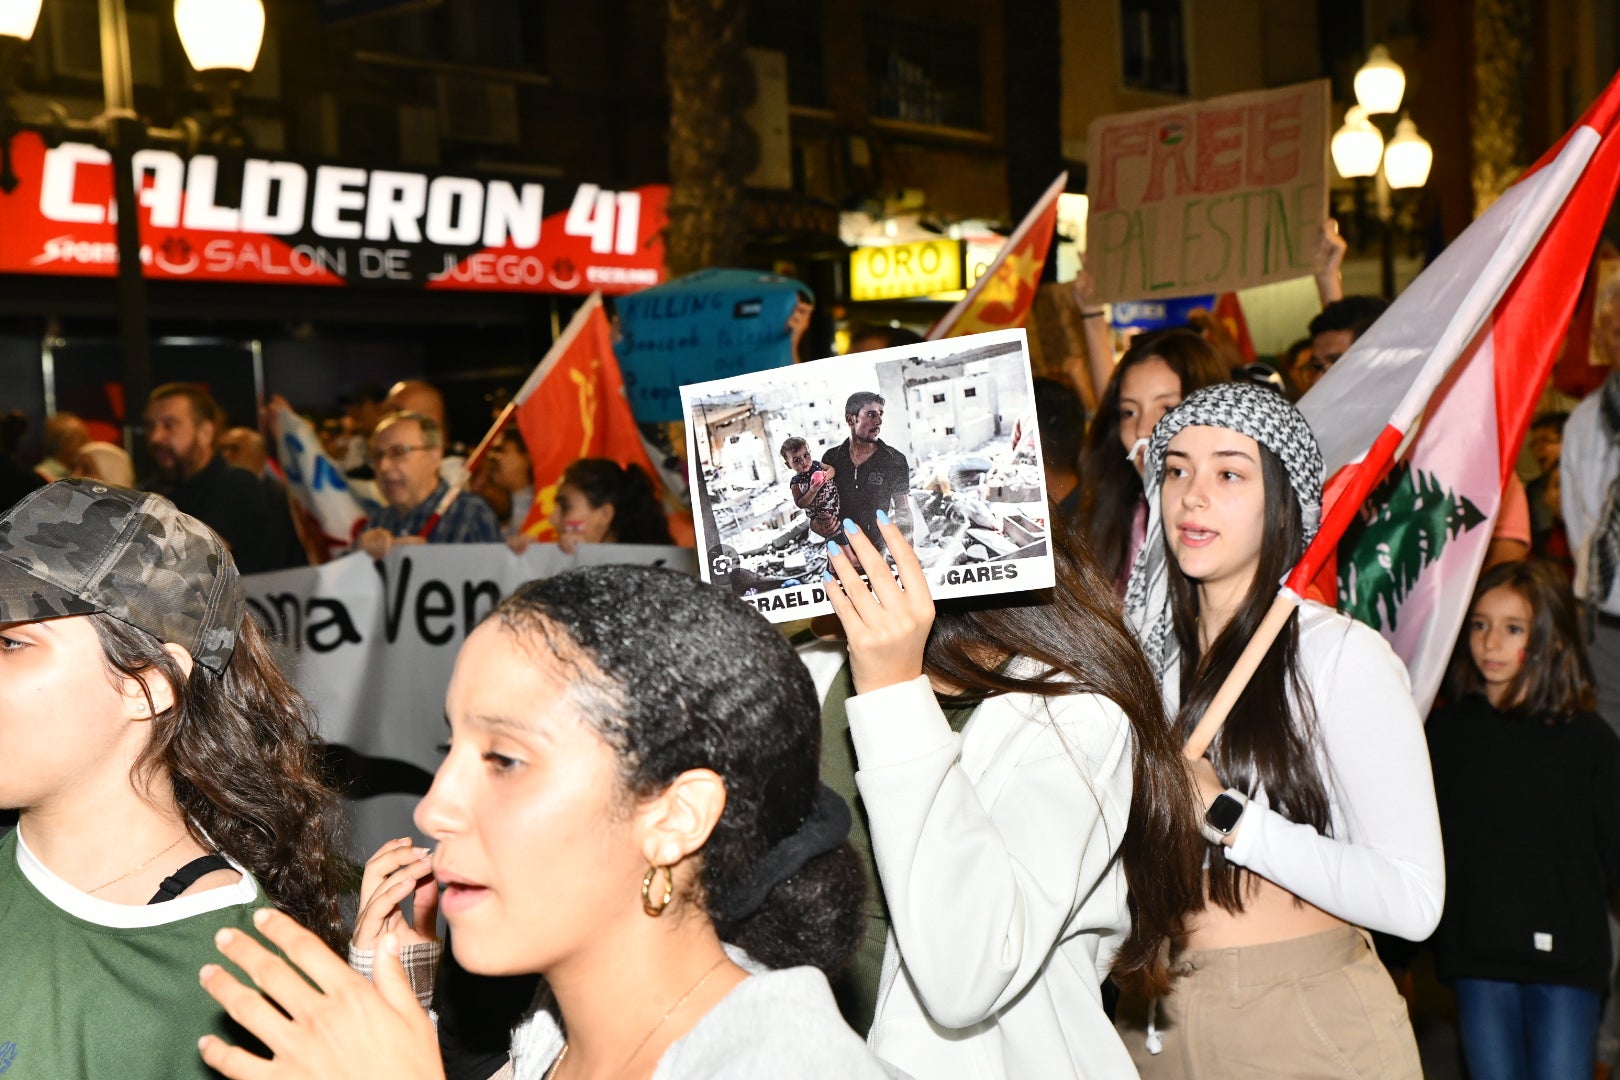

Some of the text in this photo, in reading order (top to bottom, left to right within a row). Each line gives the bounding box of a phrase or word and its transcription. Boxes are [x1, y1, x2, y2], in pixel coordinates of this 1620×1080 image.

[1093, 94, 1304, 213] FREE
[39, 141, 641, 255] CALDERON 41
[1102, 182, 1321, 293] PALESTINE
[204, 238, 545, 286] SALON DE JUEGO
[868, 242, 941, 279] ORO
[626, 292, 726, 320] KILLING
